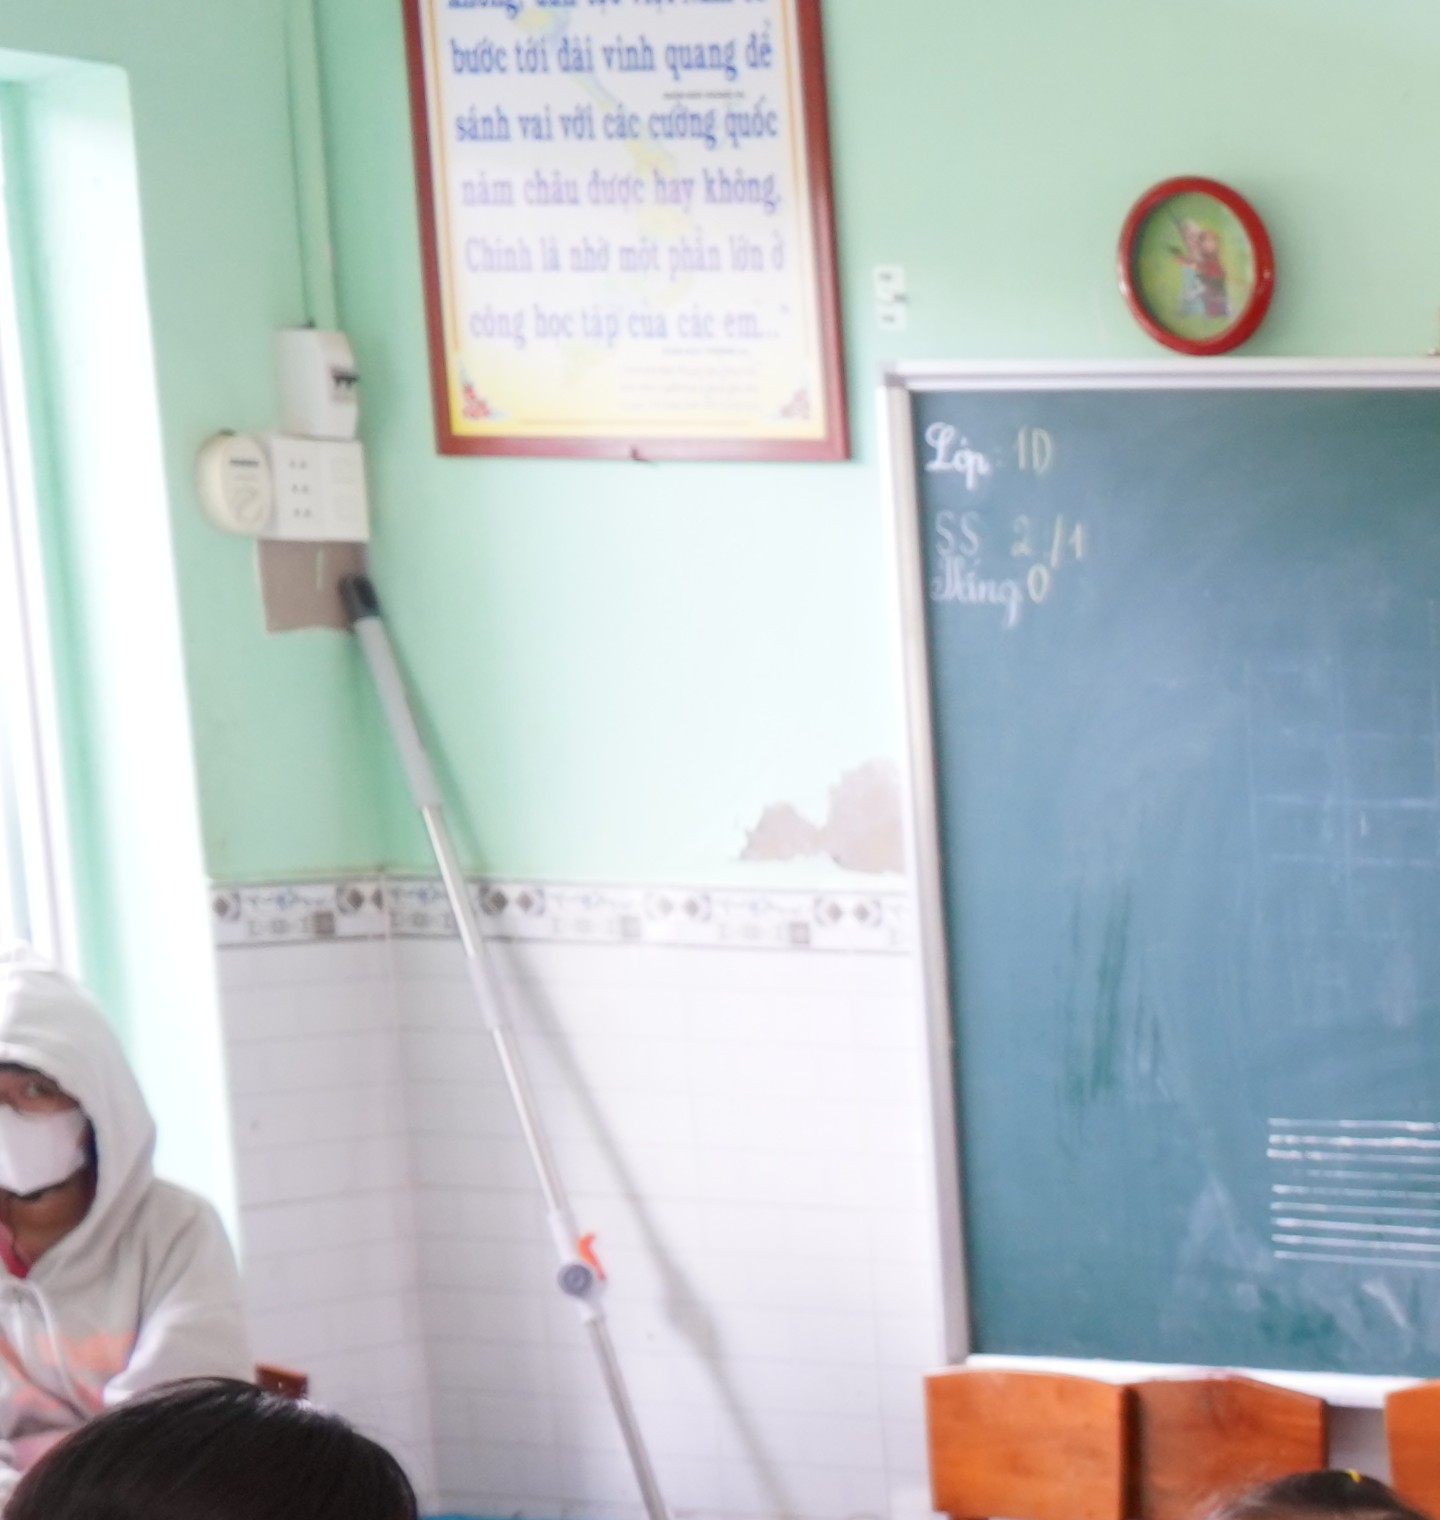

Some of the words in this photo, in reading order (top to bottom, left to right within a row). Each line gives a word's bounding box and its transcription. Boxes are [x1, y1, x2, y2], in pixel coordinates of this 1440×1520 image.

[663, 37, 740, 82] quang
[455, 103, 512, 142] sánh
[518, 105, 554, 142] vai
[653, 167, 697, 214] hay
